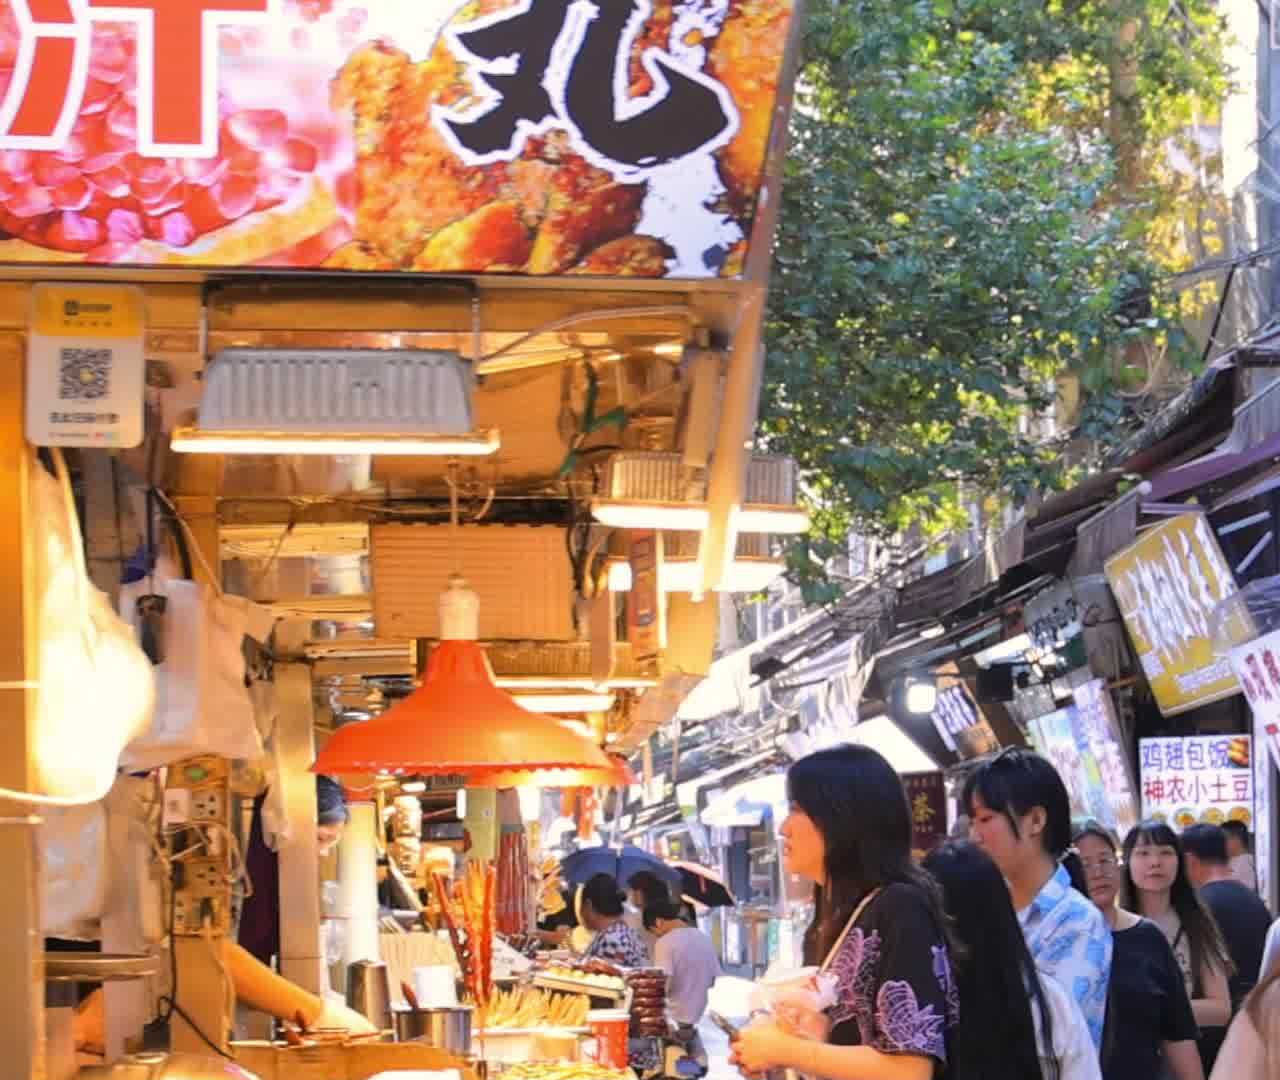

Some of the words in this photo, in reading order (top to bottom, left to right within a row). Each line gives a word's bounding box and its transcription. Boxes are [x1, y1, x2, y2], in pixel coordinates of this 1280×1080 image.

[1143, 774, 1249, 807] 神农小土豆
